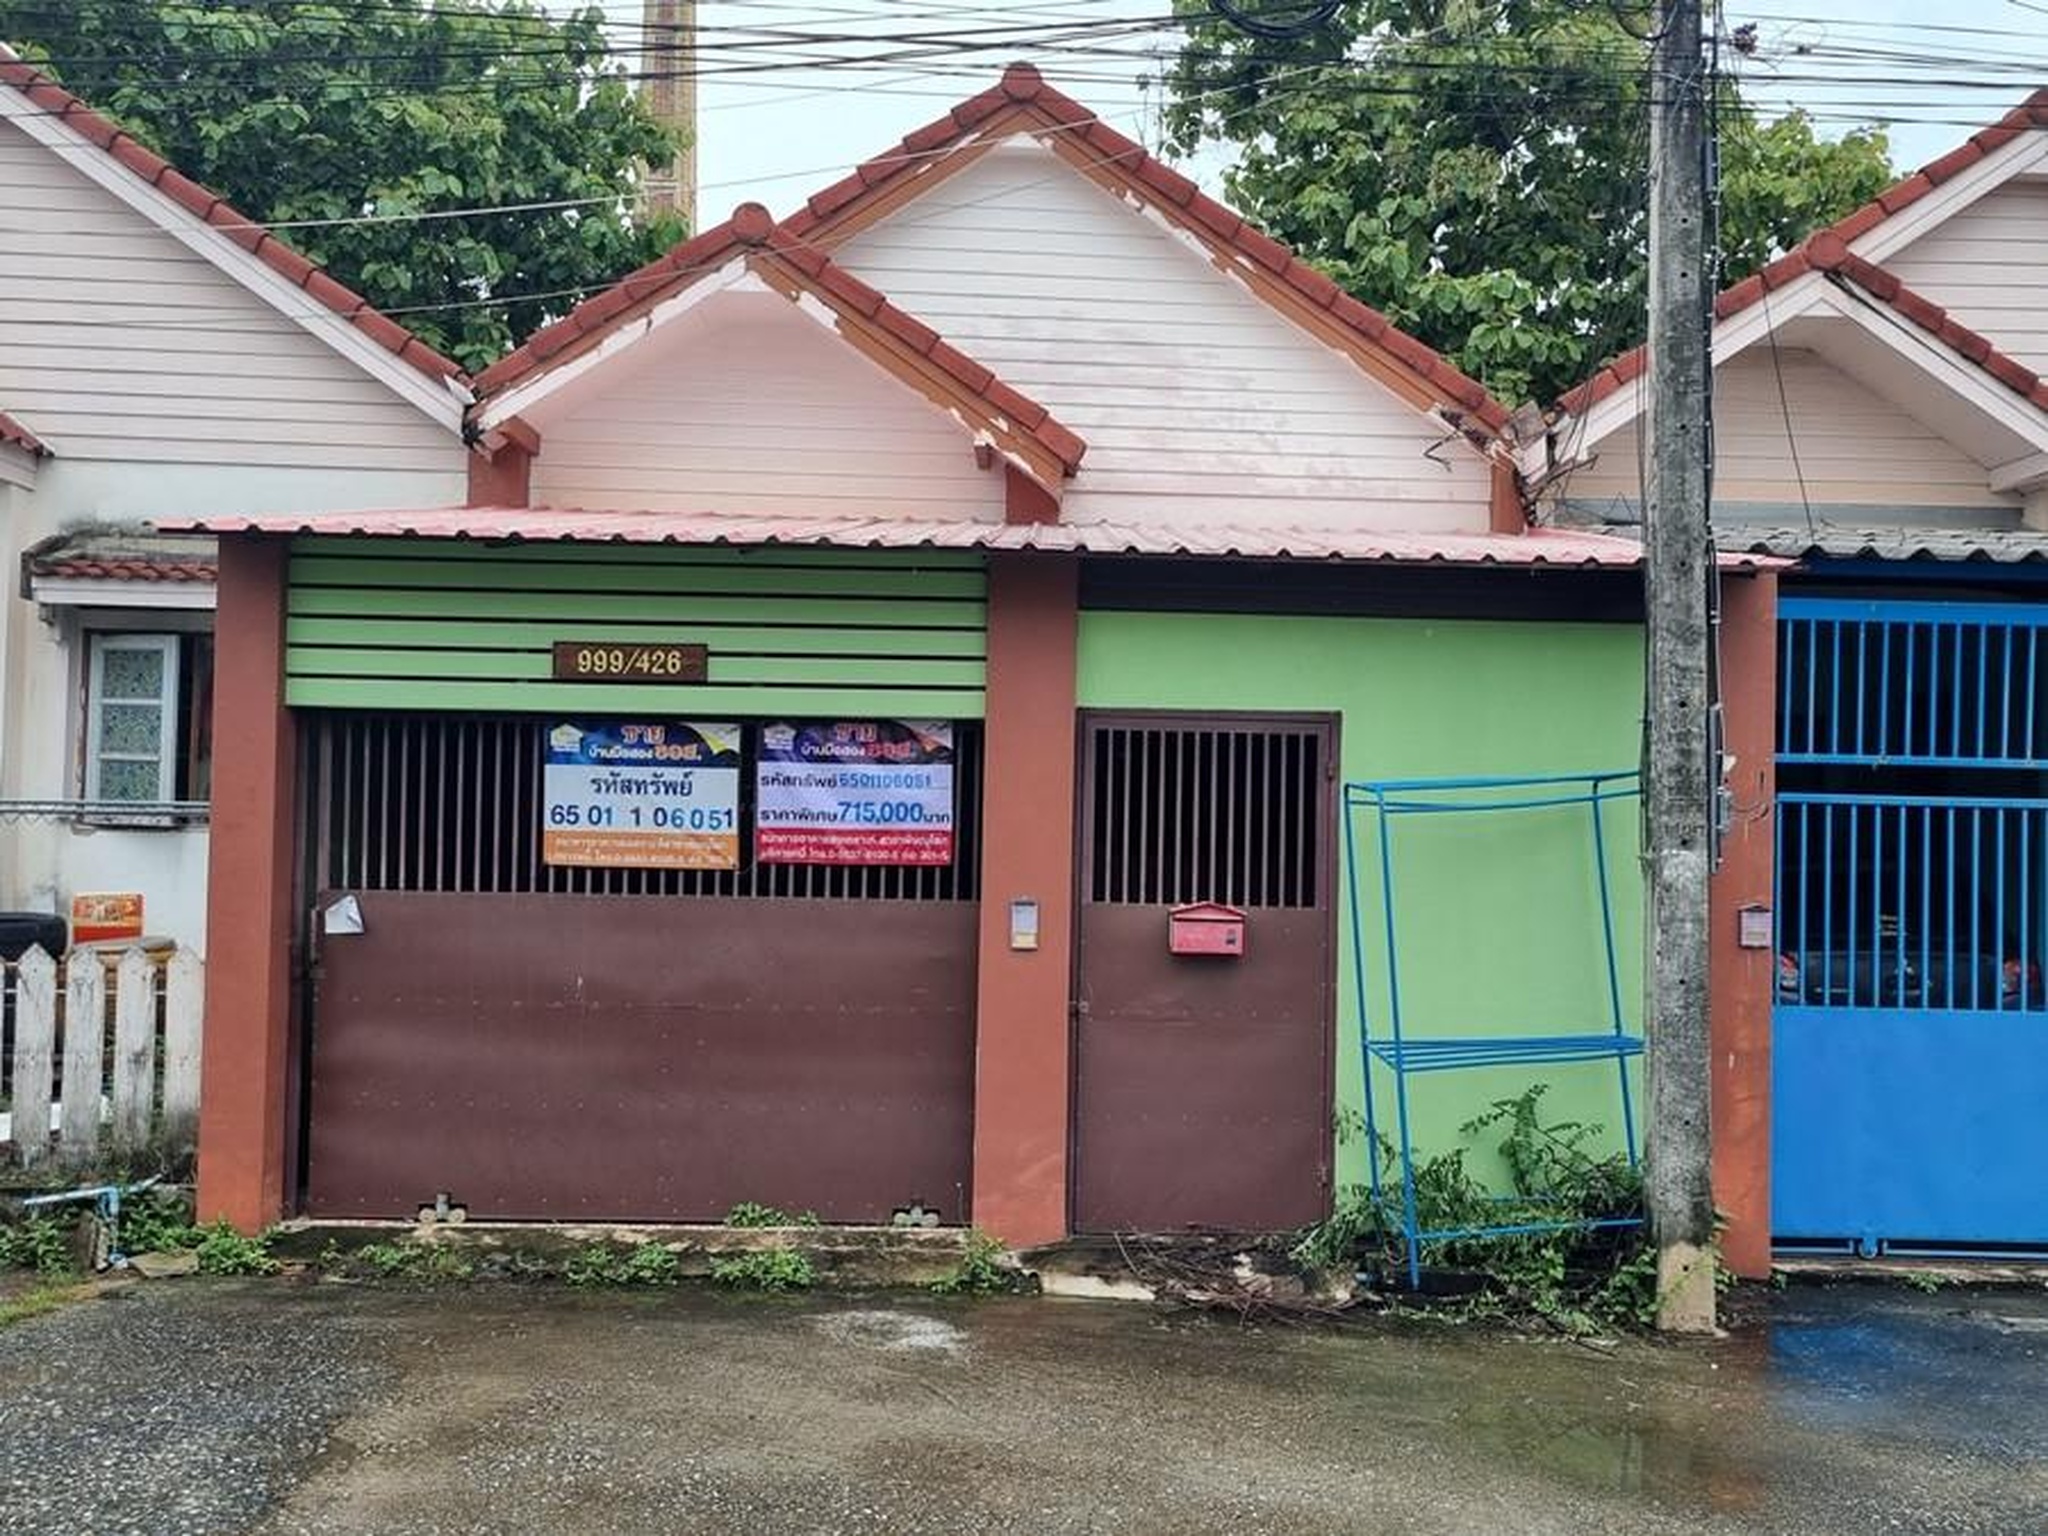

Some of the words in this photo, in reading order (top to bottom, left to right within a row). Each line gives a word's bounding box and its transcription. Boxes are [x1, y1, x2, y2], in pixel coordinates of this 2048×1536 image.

[577, 649, 682, 674] 999/426
[590, 771, 693, 796] รหัสทรัพย์
[550, 804, 580, 826] 65
[837, 801, 923, 824] 715,000
[923, 812, 950, 823] บาท
